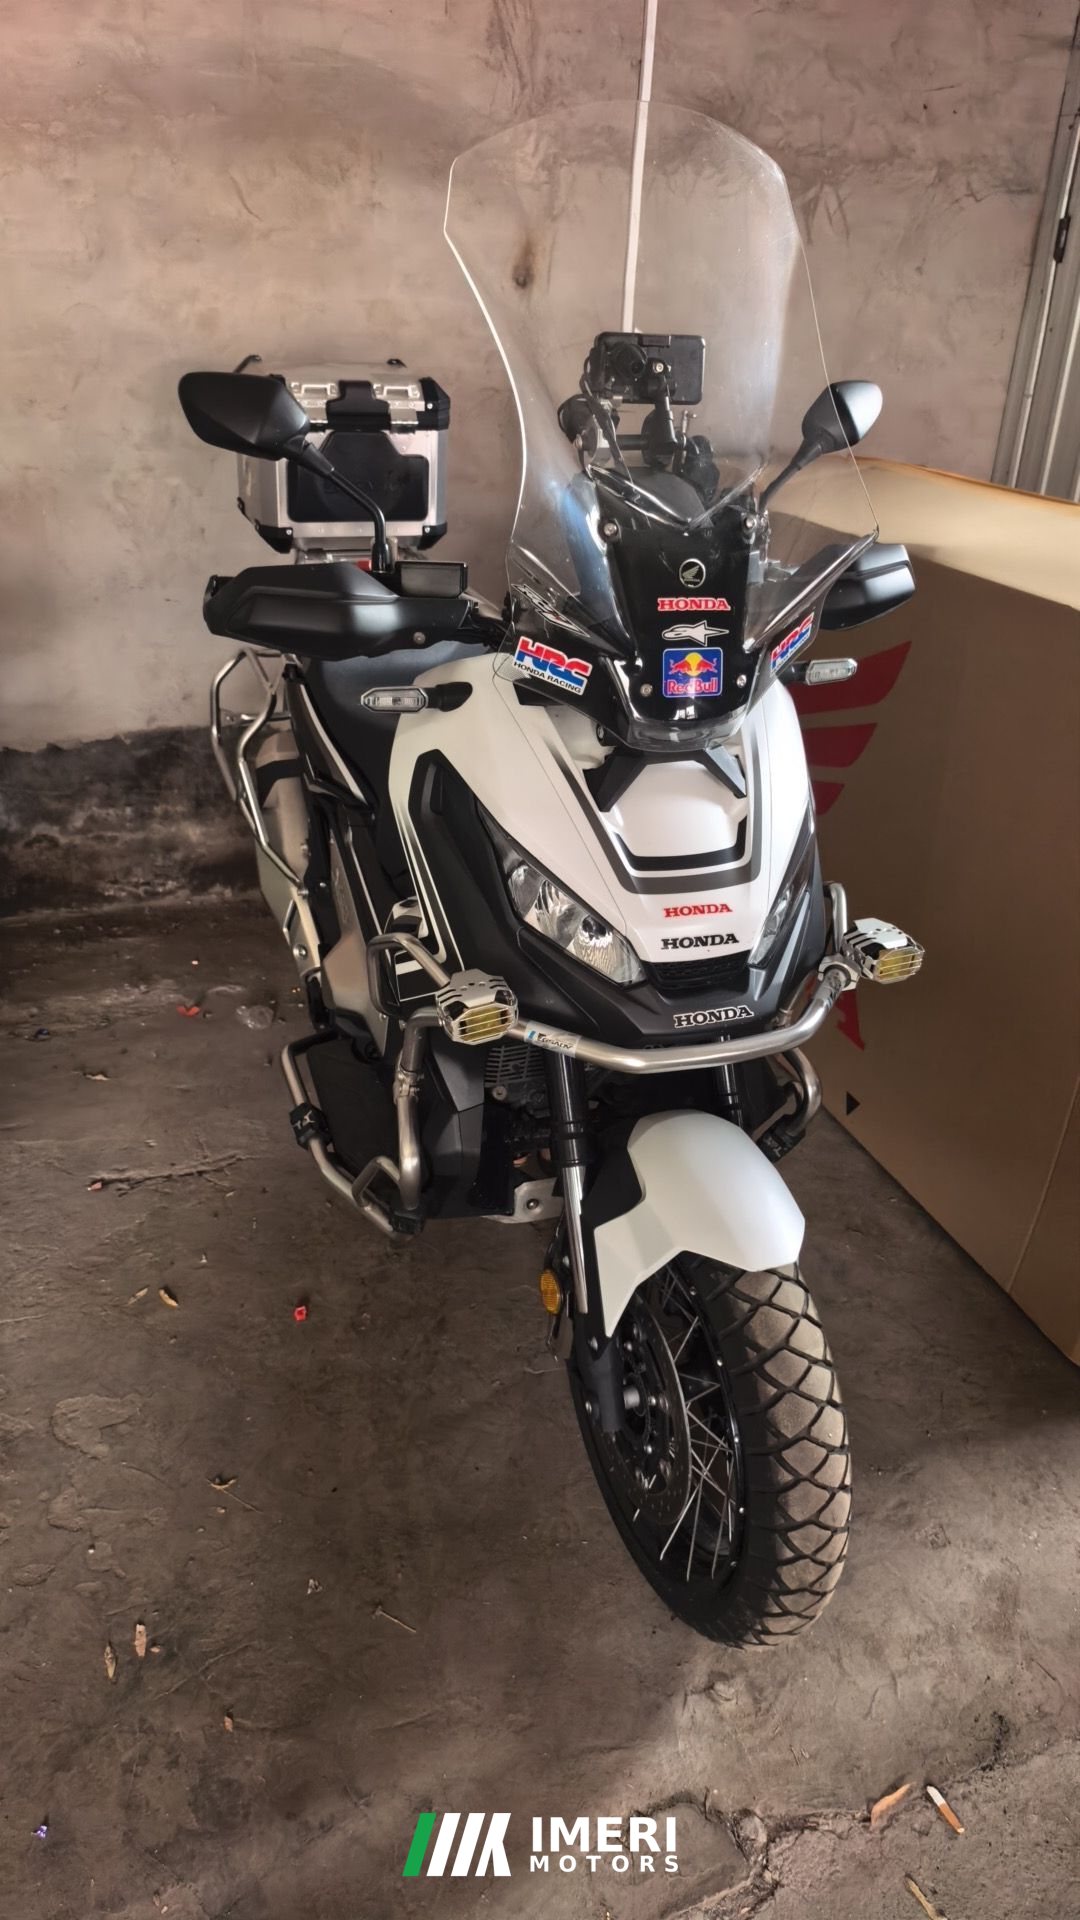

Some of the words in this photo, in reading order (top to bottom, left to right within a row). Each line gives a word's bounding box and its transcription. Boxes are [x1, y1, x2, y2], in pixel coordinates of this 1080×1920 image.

[658, 598, 731, 611] HONDA
[515, 637, 592, 688] HRC
[513, 661, 546, 680] HONDA
[546, 673, 582, 694] RACING
[695, 678, 718, 693] Bull
[663, 903, 733, 918] HONDA
[660, 933, 740, 950] HONDA
[673, 1005, 754, 1028] HONDA
